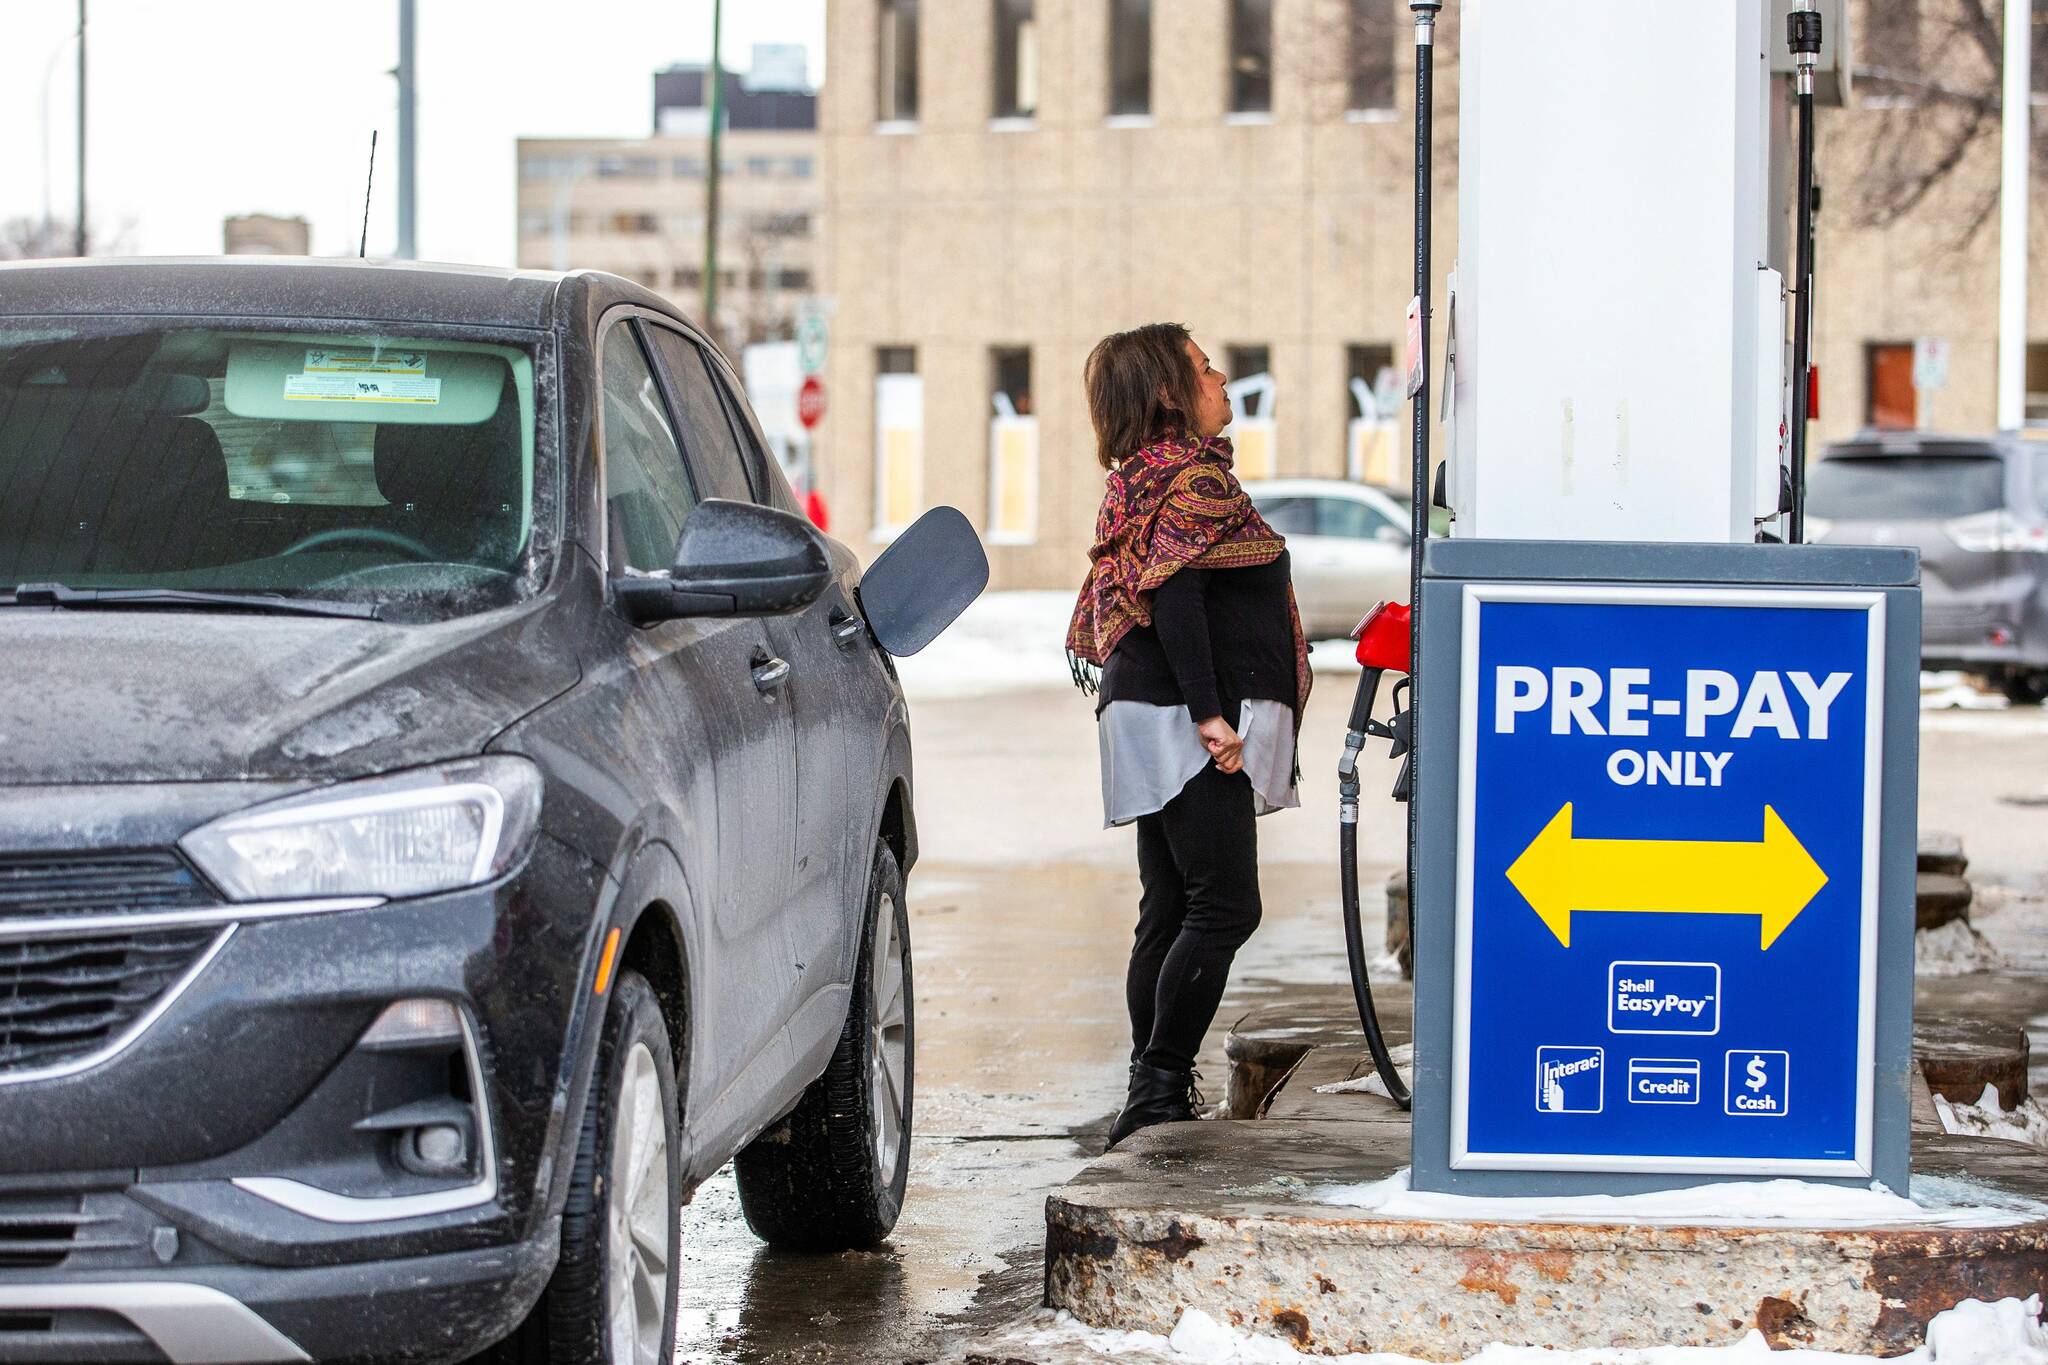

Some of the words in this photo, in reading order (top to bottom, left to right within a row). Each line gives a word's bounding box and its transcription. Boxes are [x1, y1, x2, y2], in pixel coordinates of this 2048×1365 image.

[1495, 666, 1853, 740] PRE-PAY
[1606, 749, 1734, 786] ONLY
[1618, 979, 1654, 992] Shell
[1544, 1056, 1600, 1089] Interac
[1638, 1078, 1691, 1094] Credit
[1745, 1055, 1768, 1093] $
[1735, 1094, 1777, 1110] Cash
